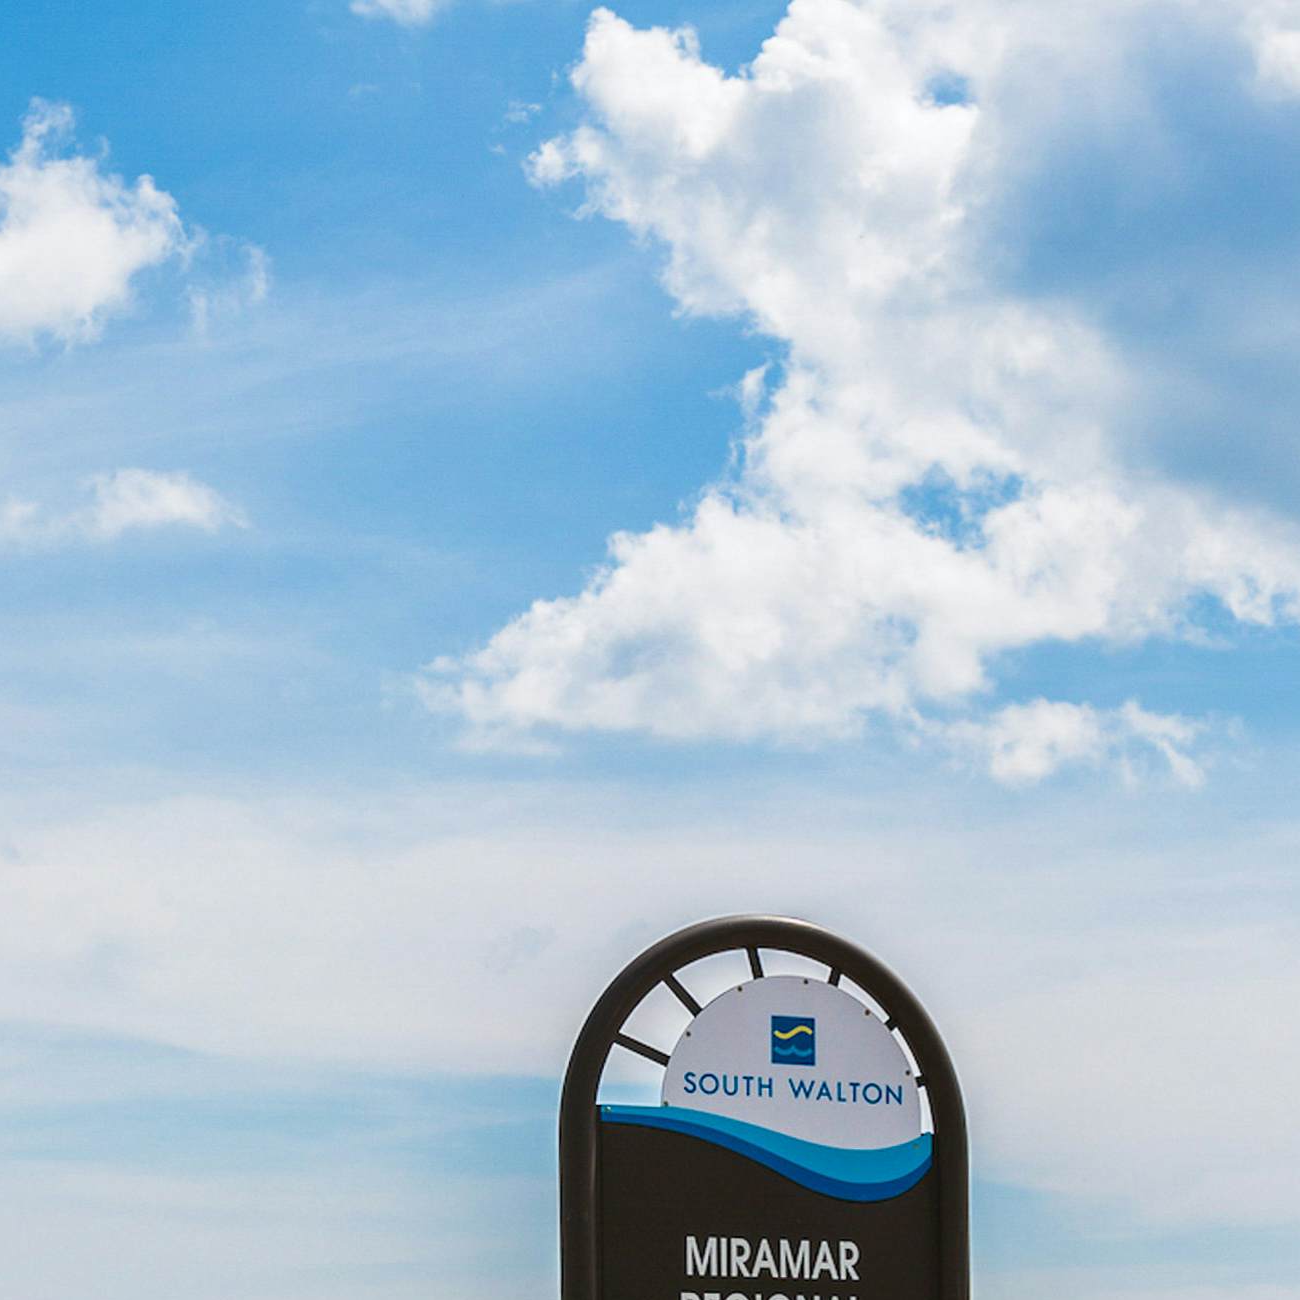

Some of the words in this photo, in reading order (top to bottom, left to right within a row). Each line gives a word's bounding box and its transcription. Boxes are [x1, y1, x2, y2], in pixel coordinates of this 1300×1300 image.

[684, 1072, 773, 1097] SOUTH
[788, 1078, 902, 1105] WALTON
[686, 1236, 860, 1280] MIRAMAR
